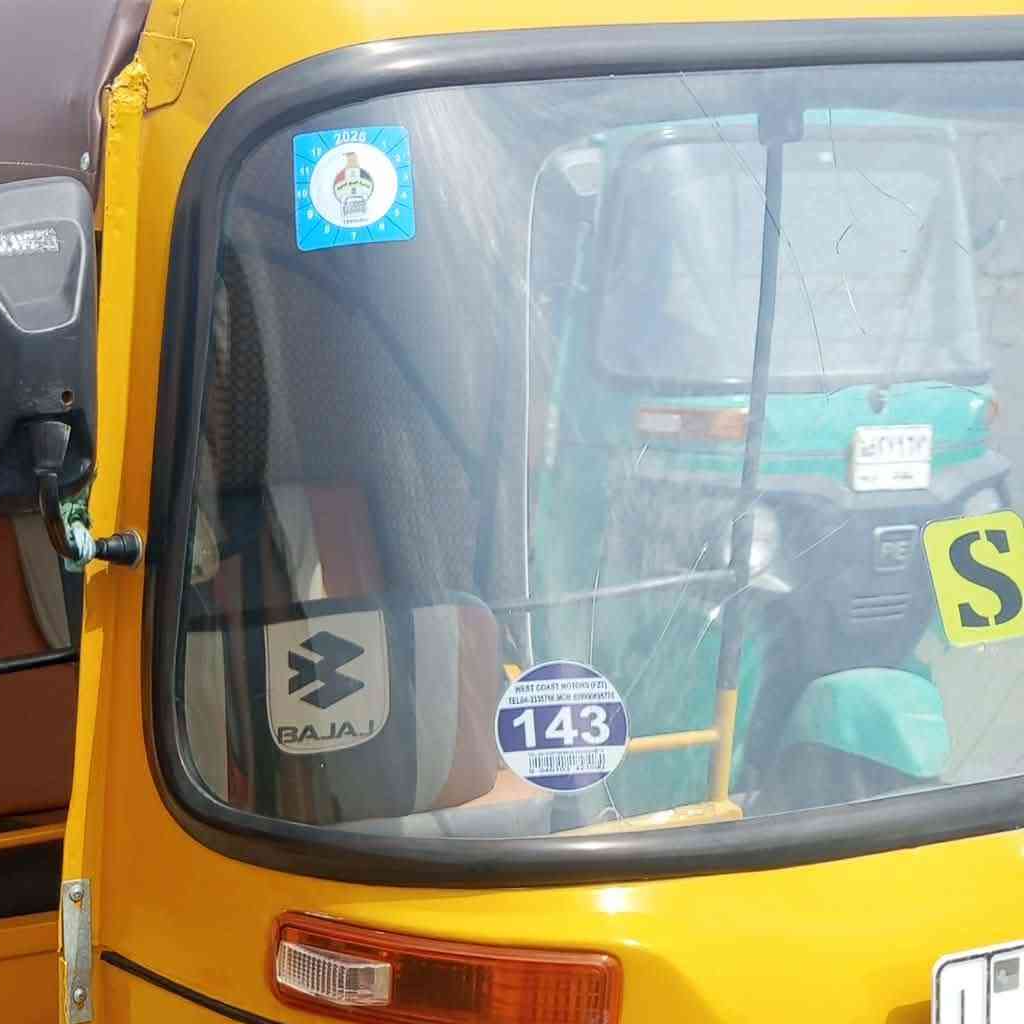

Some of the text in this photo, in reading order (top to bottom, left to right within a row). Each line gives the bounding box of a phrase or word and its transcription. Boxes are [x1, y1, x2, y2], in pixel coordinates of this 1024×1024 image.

[948, 529, 1023, 628] S
[277, 719, 375, 745] BAJAJ
[512, 704, 610, 748] 143
